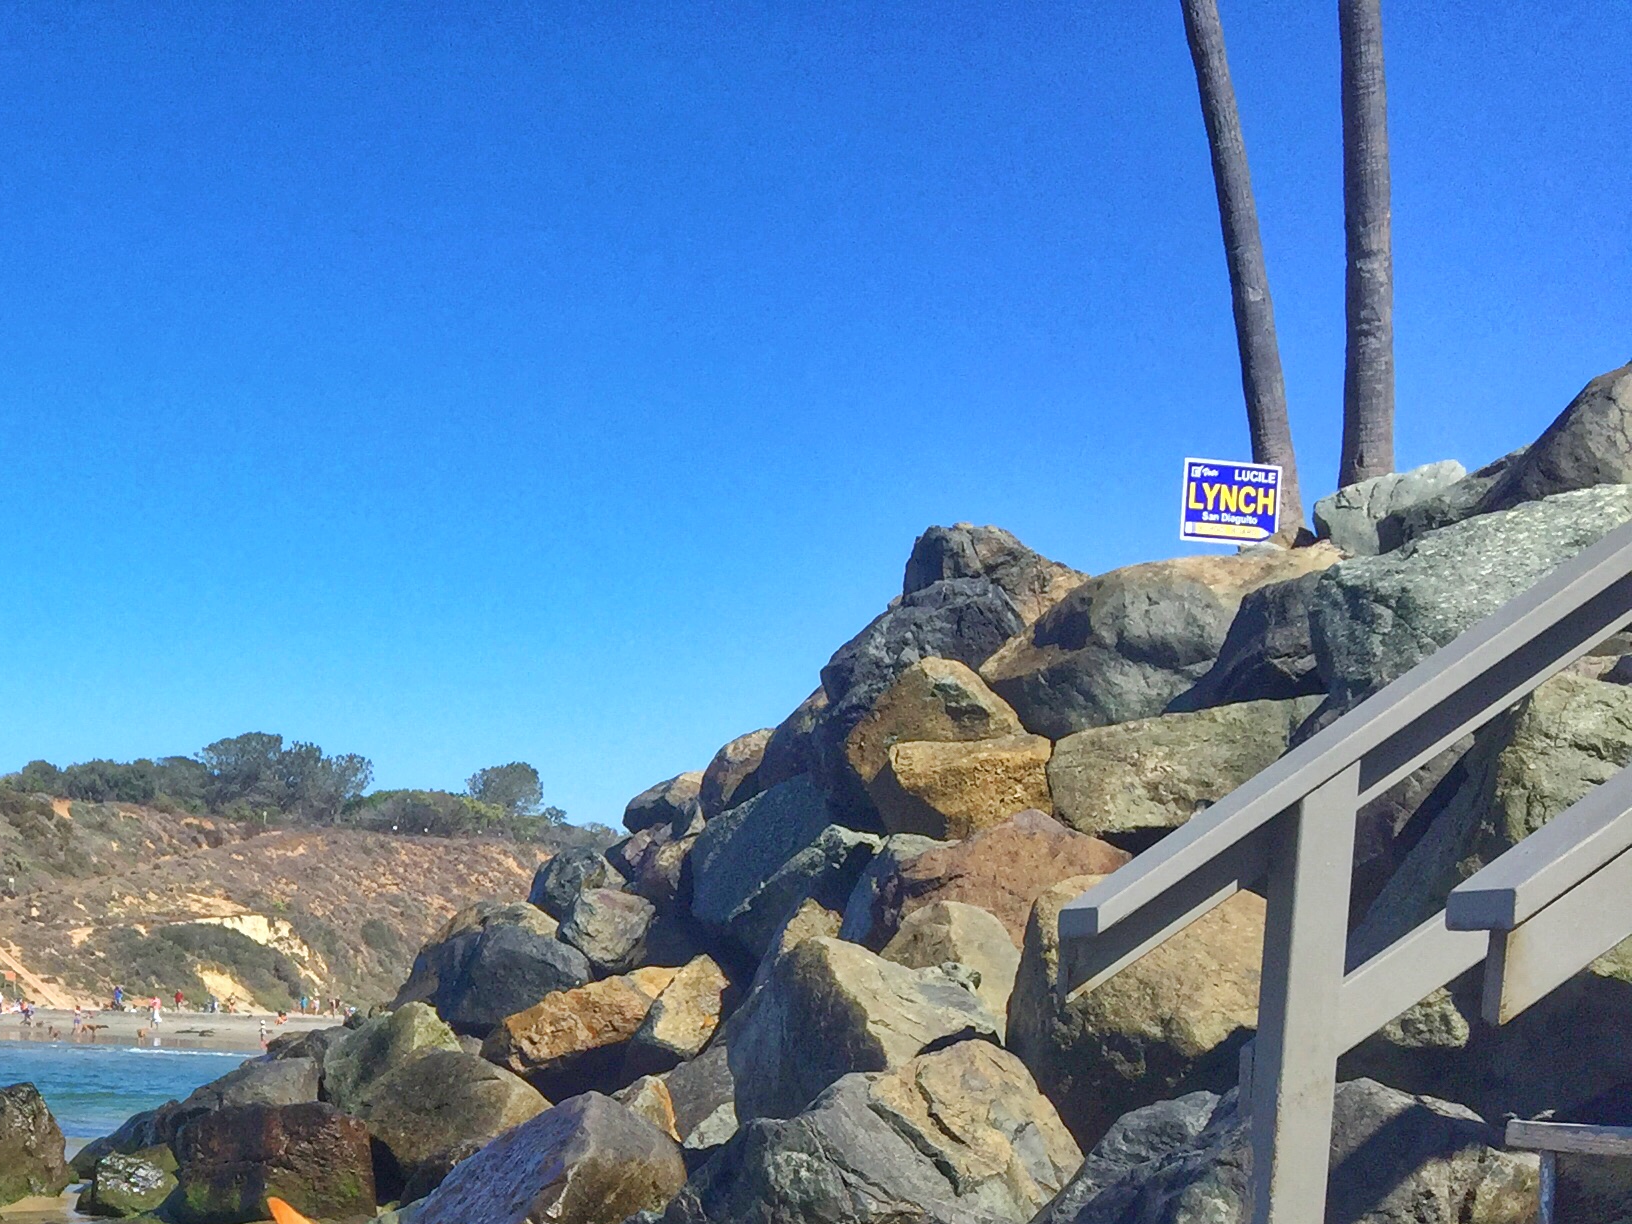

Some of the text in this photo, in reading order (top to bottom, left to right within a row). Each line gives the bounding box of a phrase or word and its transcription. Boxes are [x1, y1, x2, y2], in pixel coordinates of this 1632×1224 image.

[1235, 469, 1276, 483] LUCILE
[1189, 482, 1274, 515] LYNCH
[1202, 511, 1220, 521] San
